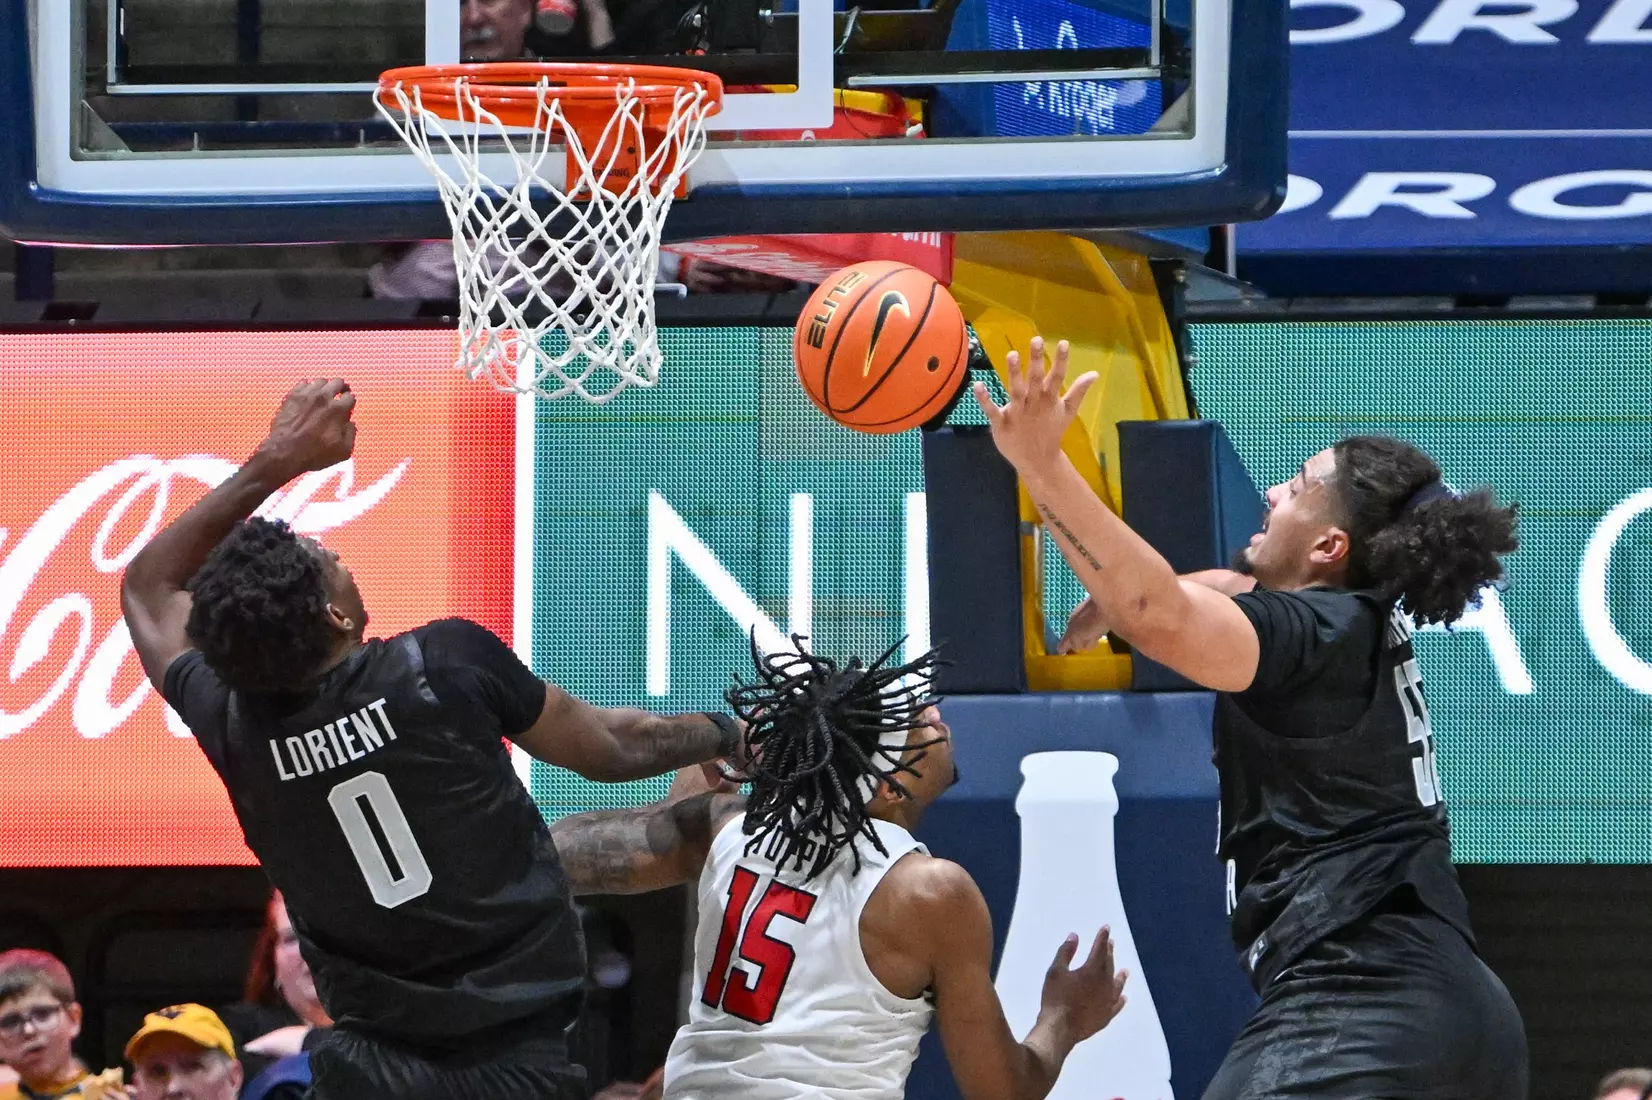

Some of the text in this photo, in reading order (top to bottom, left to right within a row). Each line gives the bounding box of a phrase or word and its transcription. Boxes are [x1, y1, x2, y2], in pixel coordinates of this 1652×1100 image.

[1275, 169, 1652, 219] RG
[806, 271, 869, 350] ELITE
[269, 698, 398, 781] LORIENT
[327, 771, 433, 909] 0
[701, 864, 818, 1026] 15
